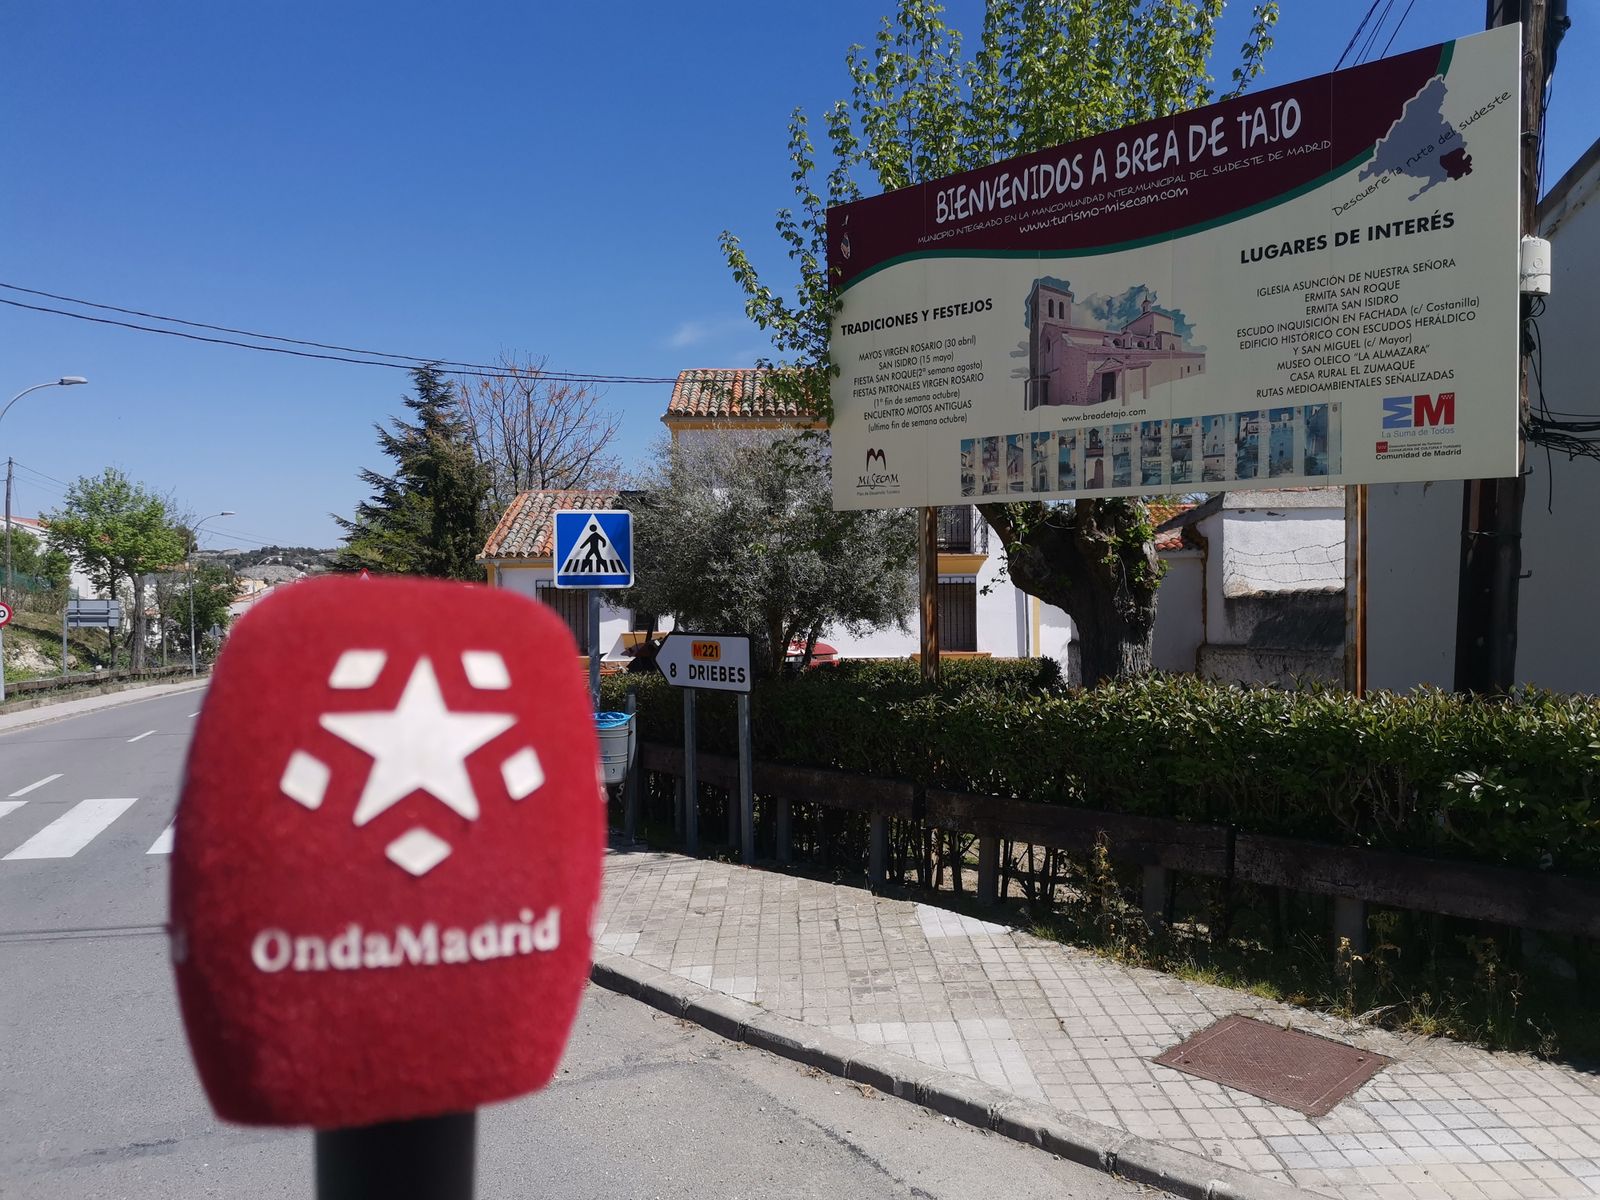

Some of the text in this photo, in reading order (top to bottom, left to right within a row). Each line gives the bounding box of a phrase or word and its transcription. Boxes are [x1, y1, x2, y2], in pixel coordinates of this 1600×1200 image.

[1392, 167, 1403, 176] la
[1406, 144, 1435, 167] ruta
[1438, 128, 1456, 145] del
[1459, 91, 1512, 130] sudeste
[936, 98, 1301, 224] BIENVENIDOS A BREA DE TAJO
[1004, 215, 1017, 223] EN
[1018, 212, 1029, 220] LA
[1032, 194, 1104, 216] MANCOMUNIDAD
[1107, 174, 1186, 199] INTERMUNICIPAL
[1190, 170, 1208, 180] DEL
[1212, 155, 1264, 175] SUDESTE
[1268, 150, 1283, 162] DE
[1287, 140, 1332, 157] MADRID
[1019, 187, 1188, 233] www.turismo-misecam.com
[1240, 210, 1455, 264] LUGARES DE INTERÉS
[1256, 258, 1456, 297] IGLESIA ASUNCIÓN DE NUESTRA SEÑORA
[1304, 279, 1400, 302] ERMITA SAN ROQUE
[840, 298, 992, 336] TRADICIONES Y FESTEJOS
[1236, 296, 1480, 338] ESCUDO INQUISICIÓN EN FACHADA (c/ Costanilla)
[1306, 294, 1399, 315] ERMITA SAN ISIDRO
[1239, 310, 1476, 350] EDIFICIO HISTÓRICO CON ESCUDOS HERÁLDICO
[858, 334, 976, 361] MAYOS VIRGEN ROSARIO (30 abril)
[1292, 333, 1412, 355] Y SAN MIGUEL (c/ Mayor)
[853, 375, 875, 386] FIESTA
[875, 373, 890, 383] SAN
[927, 366, 955, 376] semana
[956, 360, 983, 373] agosto)
[878, 351, 954, 371] SAN ISIDRO (15 mayo)
[1276, 358, 1311, 370] MUSEO
[1313, 353, 1351, 366] OLEICO
[1290, 359, 1415, 382] CASA RURAL EL ZUMAQUE
[853, 372, 984, 398] FIESTAS PATRONALES VIRGEN ROSARIO
[1256, 369, 1454, 398] RUTAS MEDIOAMBIENTALES SEÑALIZADAS
[863, 399, 972, 420] ENCUENTRO MOTOS ANTIGUAS
[884, 397, 893, 406] fin
[894, 395, 903, 405] de
[904, 394, 931, 404] semana
[932, 388, 960, 400] octubre)
[891, 420, 900, 429] fin
[901, 419, 910, 428] de
[911, 418, 938, 427] semana
[938, 412, 968, 424] octubre)
[1062, 409, 1146, 423] www.breadetajo.com
[1376, 451, 1420, 460] Comunidad
[670, 662, 746, 683] 8 DRIEBES
[251, 906, 561, 973] OndaMadrid
